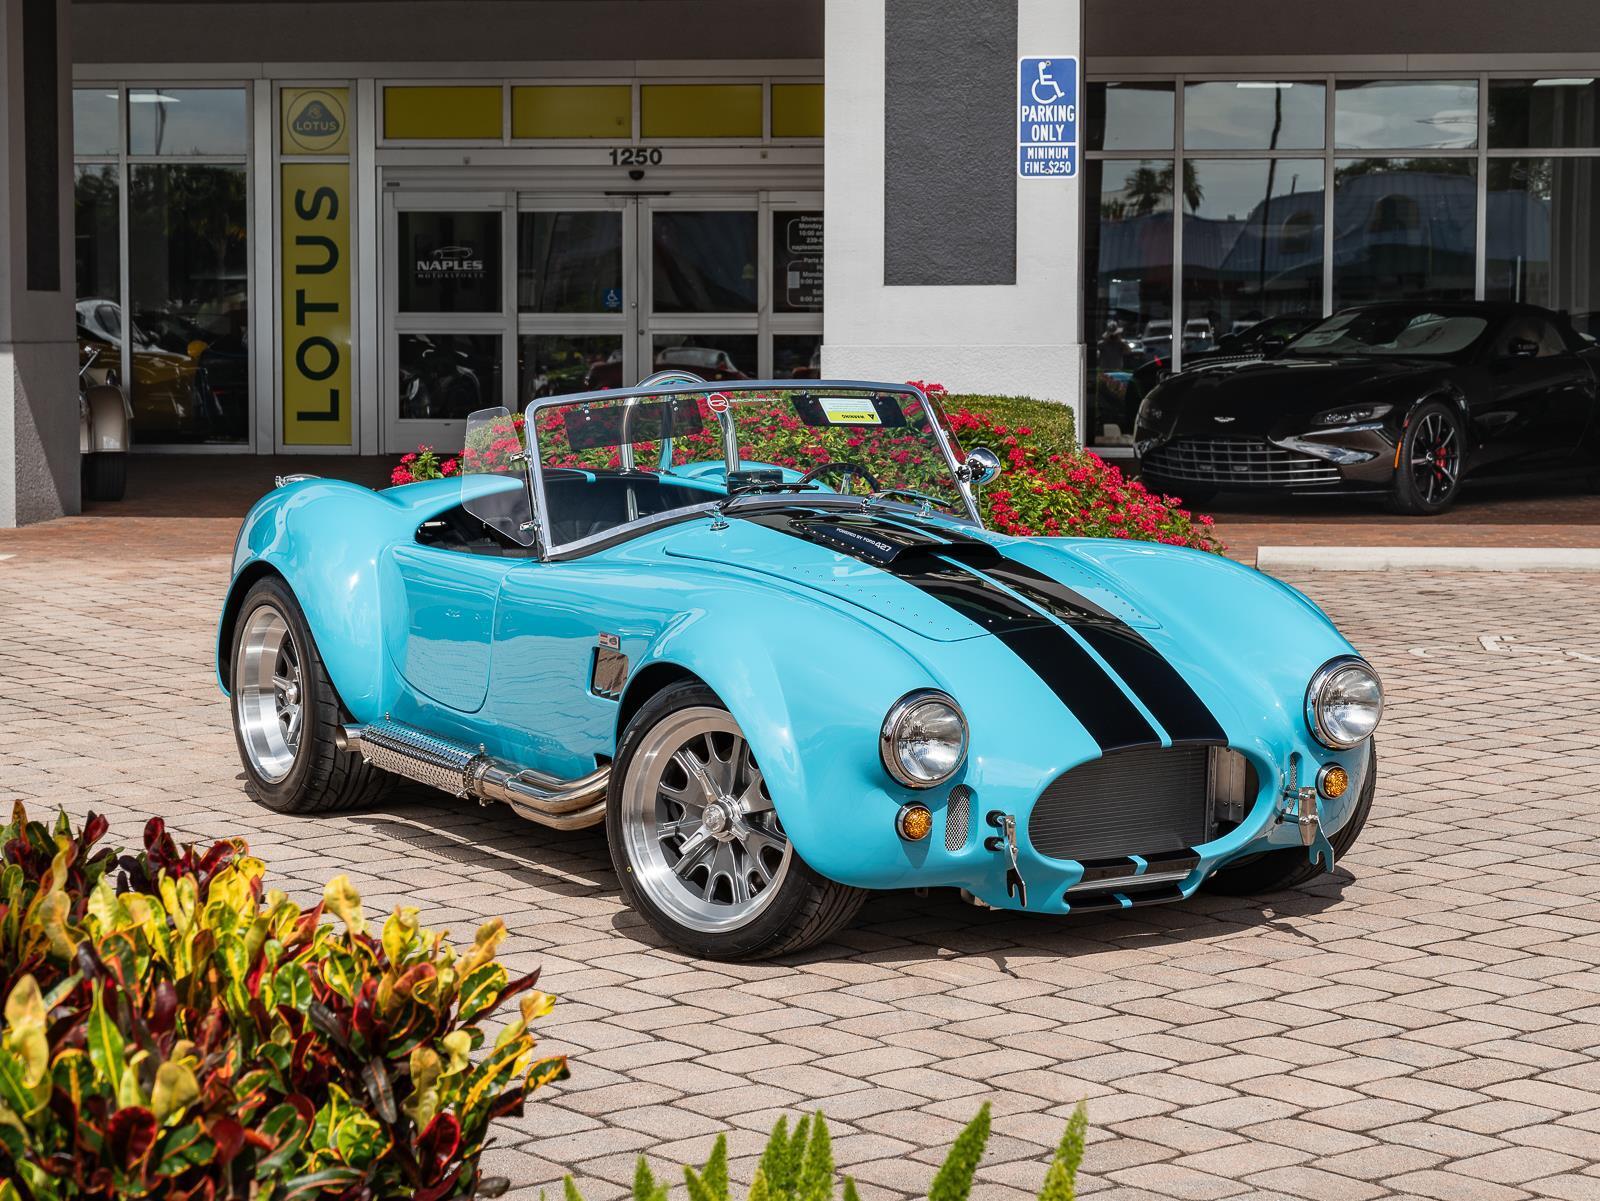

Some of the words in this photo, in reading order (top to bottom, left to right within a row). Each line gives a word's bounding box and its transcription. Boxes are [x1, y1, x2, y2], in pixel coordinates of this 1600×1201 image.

[1021, 105, 1075, 122] PARKING
[296, 121, 337, 131] LOTUS
[1031, 124, 1065, 142] ONLY
[609, 148, 663, 165] 1250
[1027, 147, 1069, 160] MINIMUM
[1024, 161, 1046, 174] FINE
[1048, 160, 1072, 175] $250
[417, 260, 483, 271] NAPLES
[295, 186, 340, 422] LOTUS
[836, 527, 857, 538] POWERED
[863, 537, 876, 545] FORD
[875, 541, 892, 552] 427
